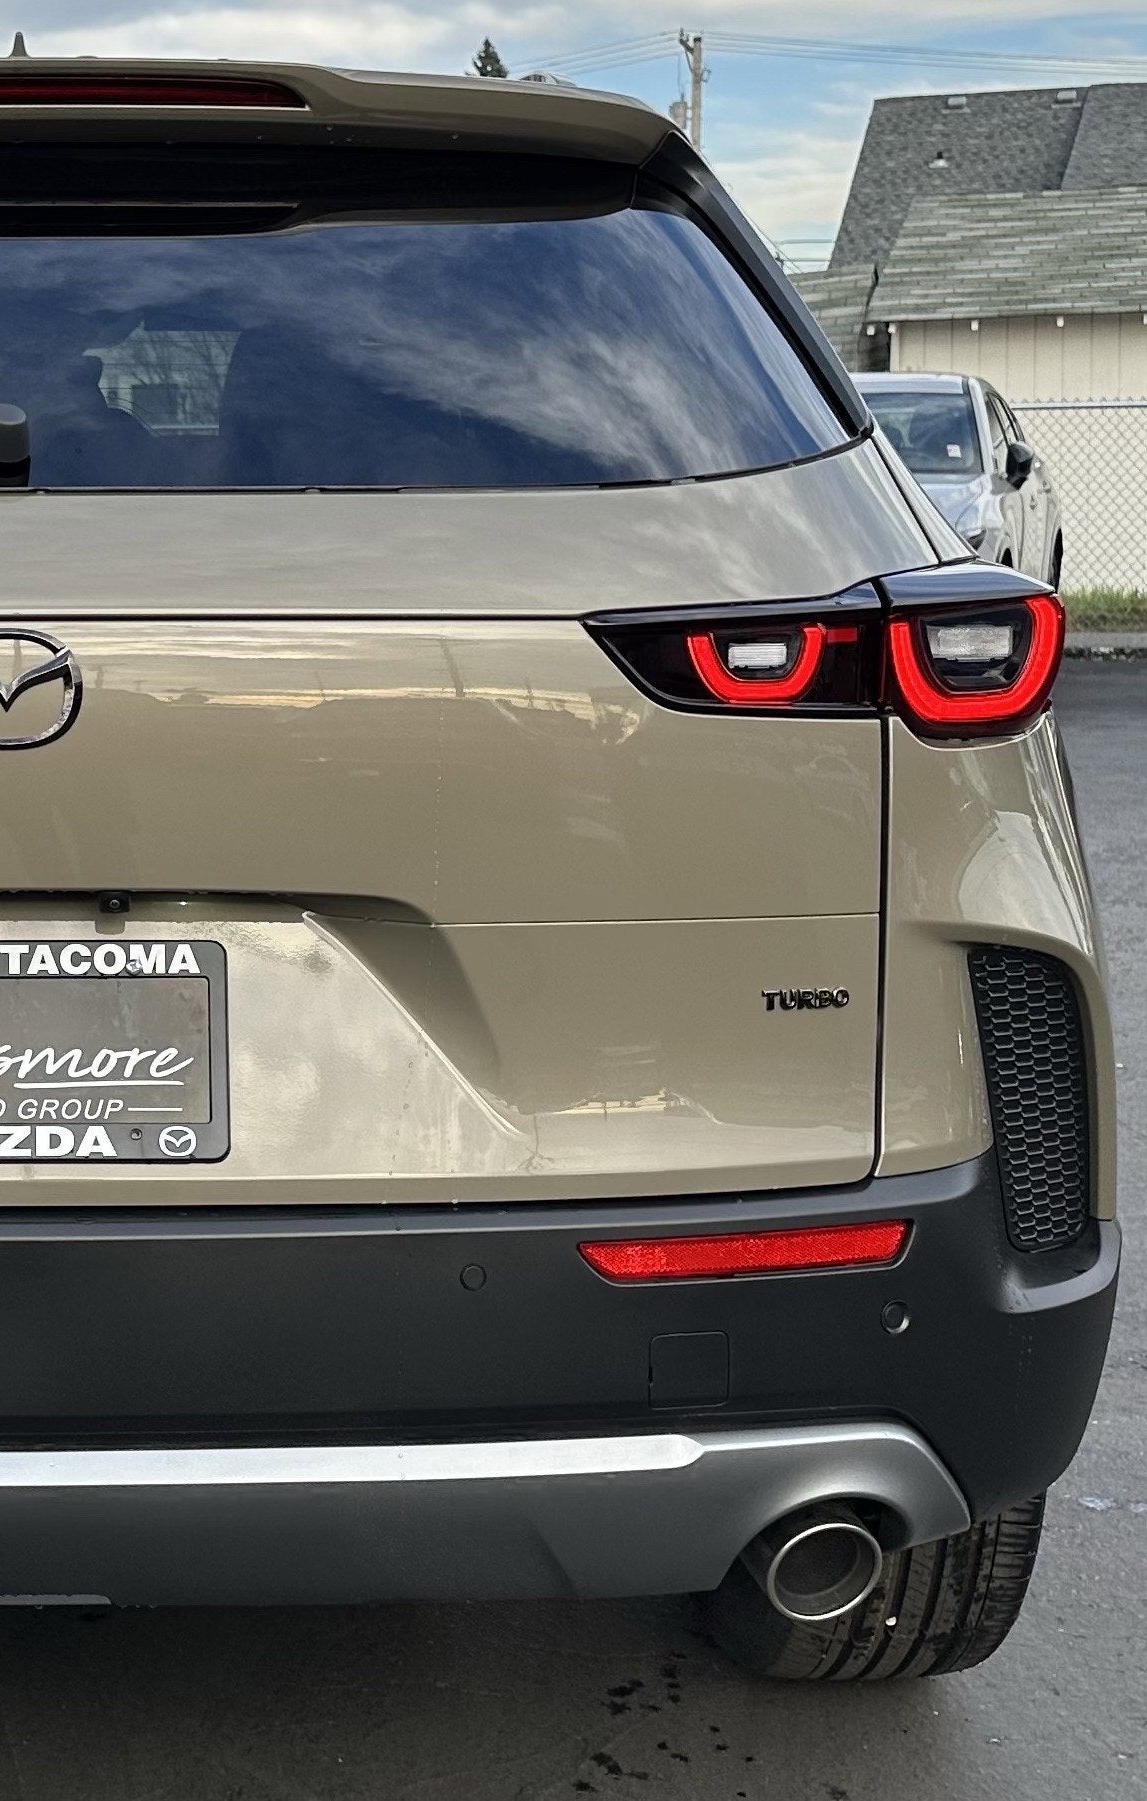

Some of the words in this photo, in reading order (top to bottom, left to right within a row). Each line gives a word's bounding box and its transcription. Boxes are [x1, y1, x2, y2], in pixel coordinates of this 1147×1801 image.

[0, 943, 201, 976] TACOMA
[761, 987, 850, 1011] TURBO
[17, 1099, 124, 1120] GROUP
